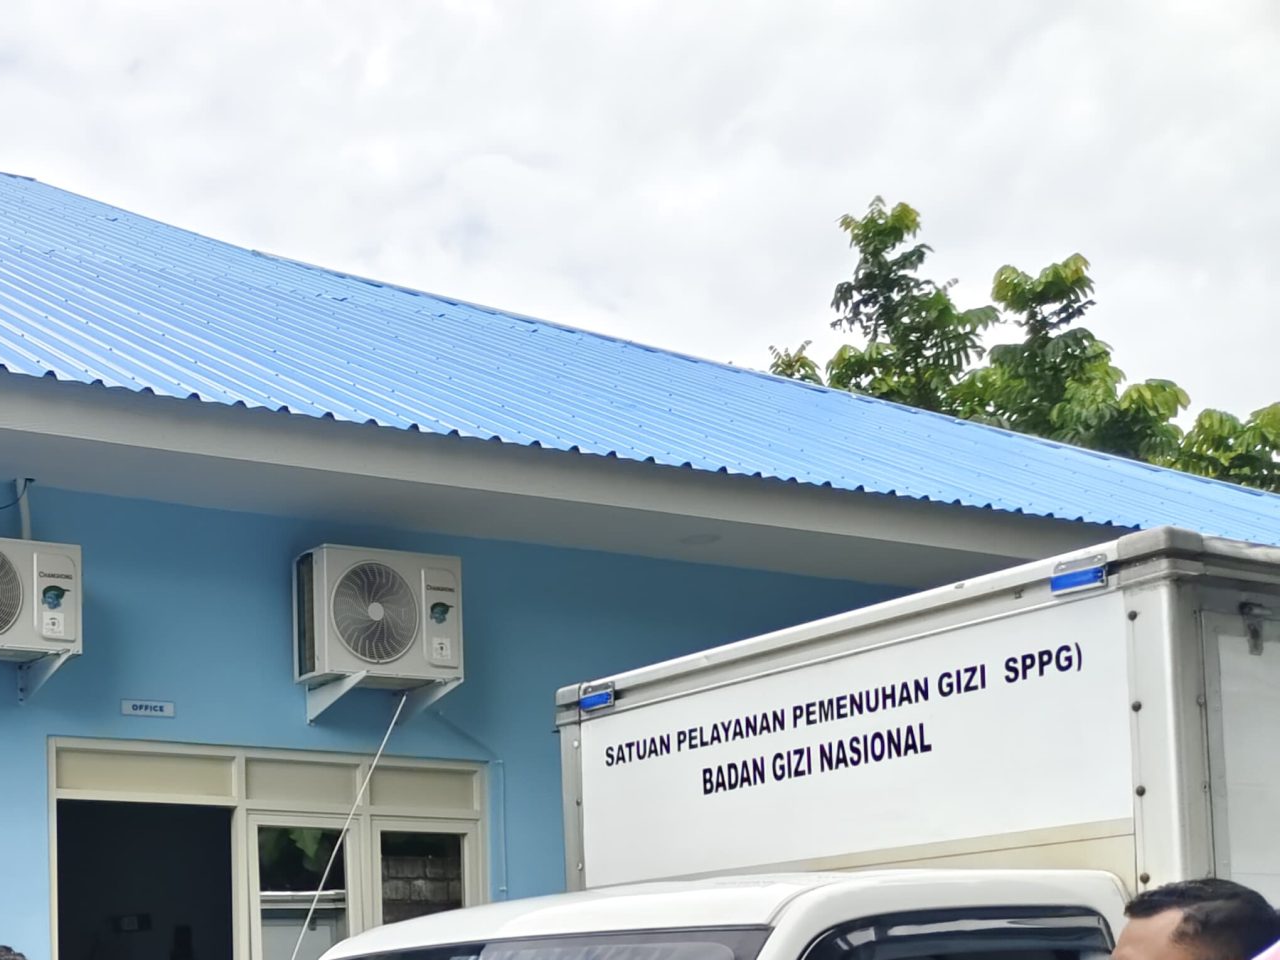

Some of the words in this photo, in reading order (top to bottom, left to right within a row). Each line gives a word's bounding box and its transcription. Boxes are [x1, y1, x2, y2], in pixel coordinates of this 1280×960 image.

[131, 703, 165, 713] OFFICE
[605, 733, 671, 767] SATUAN
[676, 708, 786, 752] PELAYANAN
[792, 676, 930, 729] PEMENUHAN
[937, 663, 987, 698] GIZI
[1003, 641, 1083, 684] SPPG)
[702, 756, 766, 796] BADAN
[772, 746, 813, 782] GIZI
[819, 722, 933, 773] NASIONAL
